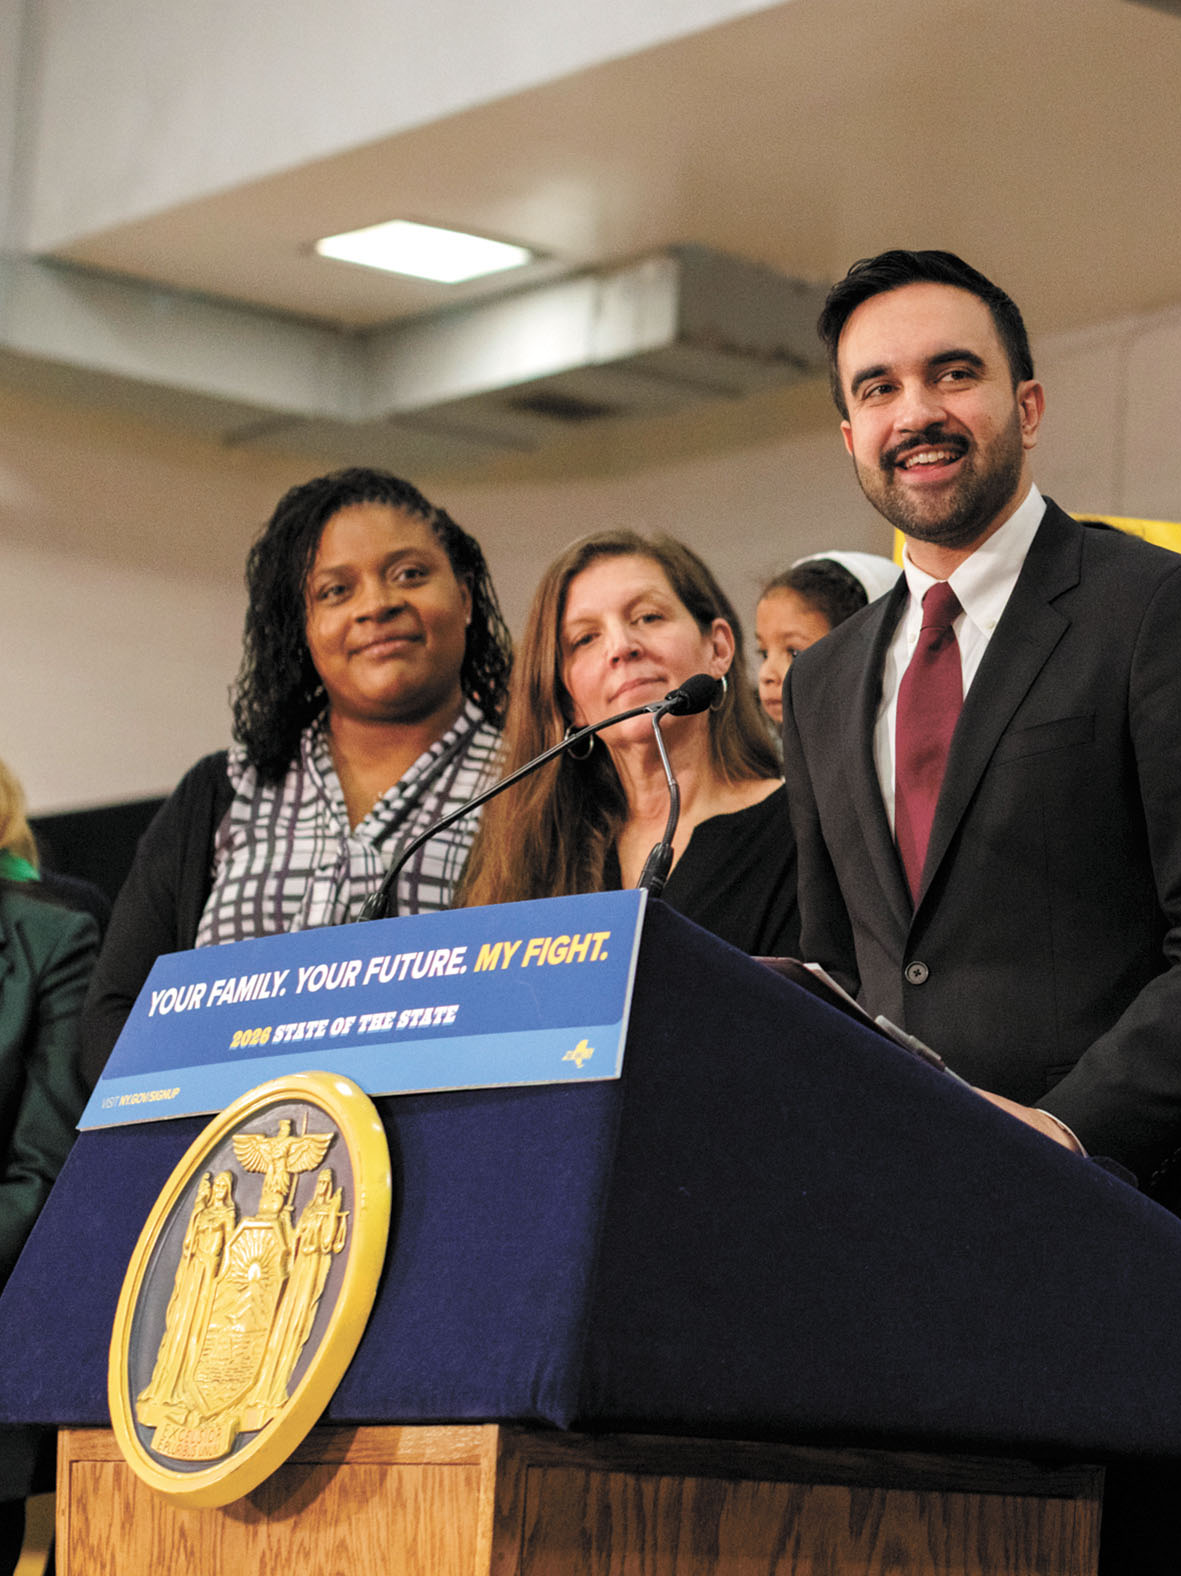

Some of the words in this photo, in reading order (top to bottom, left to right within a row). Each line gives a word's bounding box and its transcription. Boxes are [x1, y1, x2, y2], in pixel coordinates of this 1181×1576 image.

[148, 982, 207, 1017] YOUR
[207, 969, 291, 1007] FAMILY.
[295, 959, 362, 994] YOUR
[362, 946, 468, 986] FUTURE.
[474, 940, 523, 973] MY
[521, 931, 611, 968] FIGHT.
[229, 1026, 272, 1049] 2026
[272, 1019, 330, 1044] STATE
[329, 1015, 357, 1038] OF
[357, 1010, 398, 1035] THE
[396, 1004, 460, 1030] STATE
